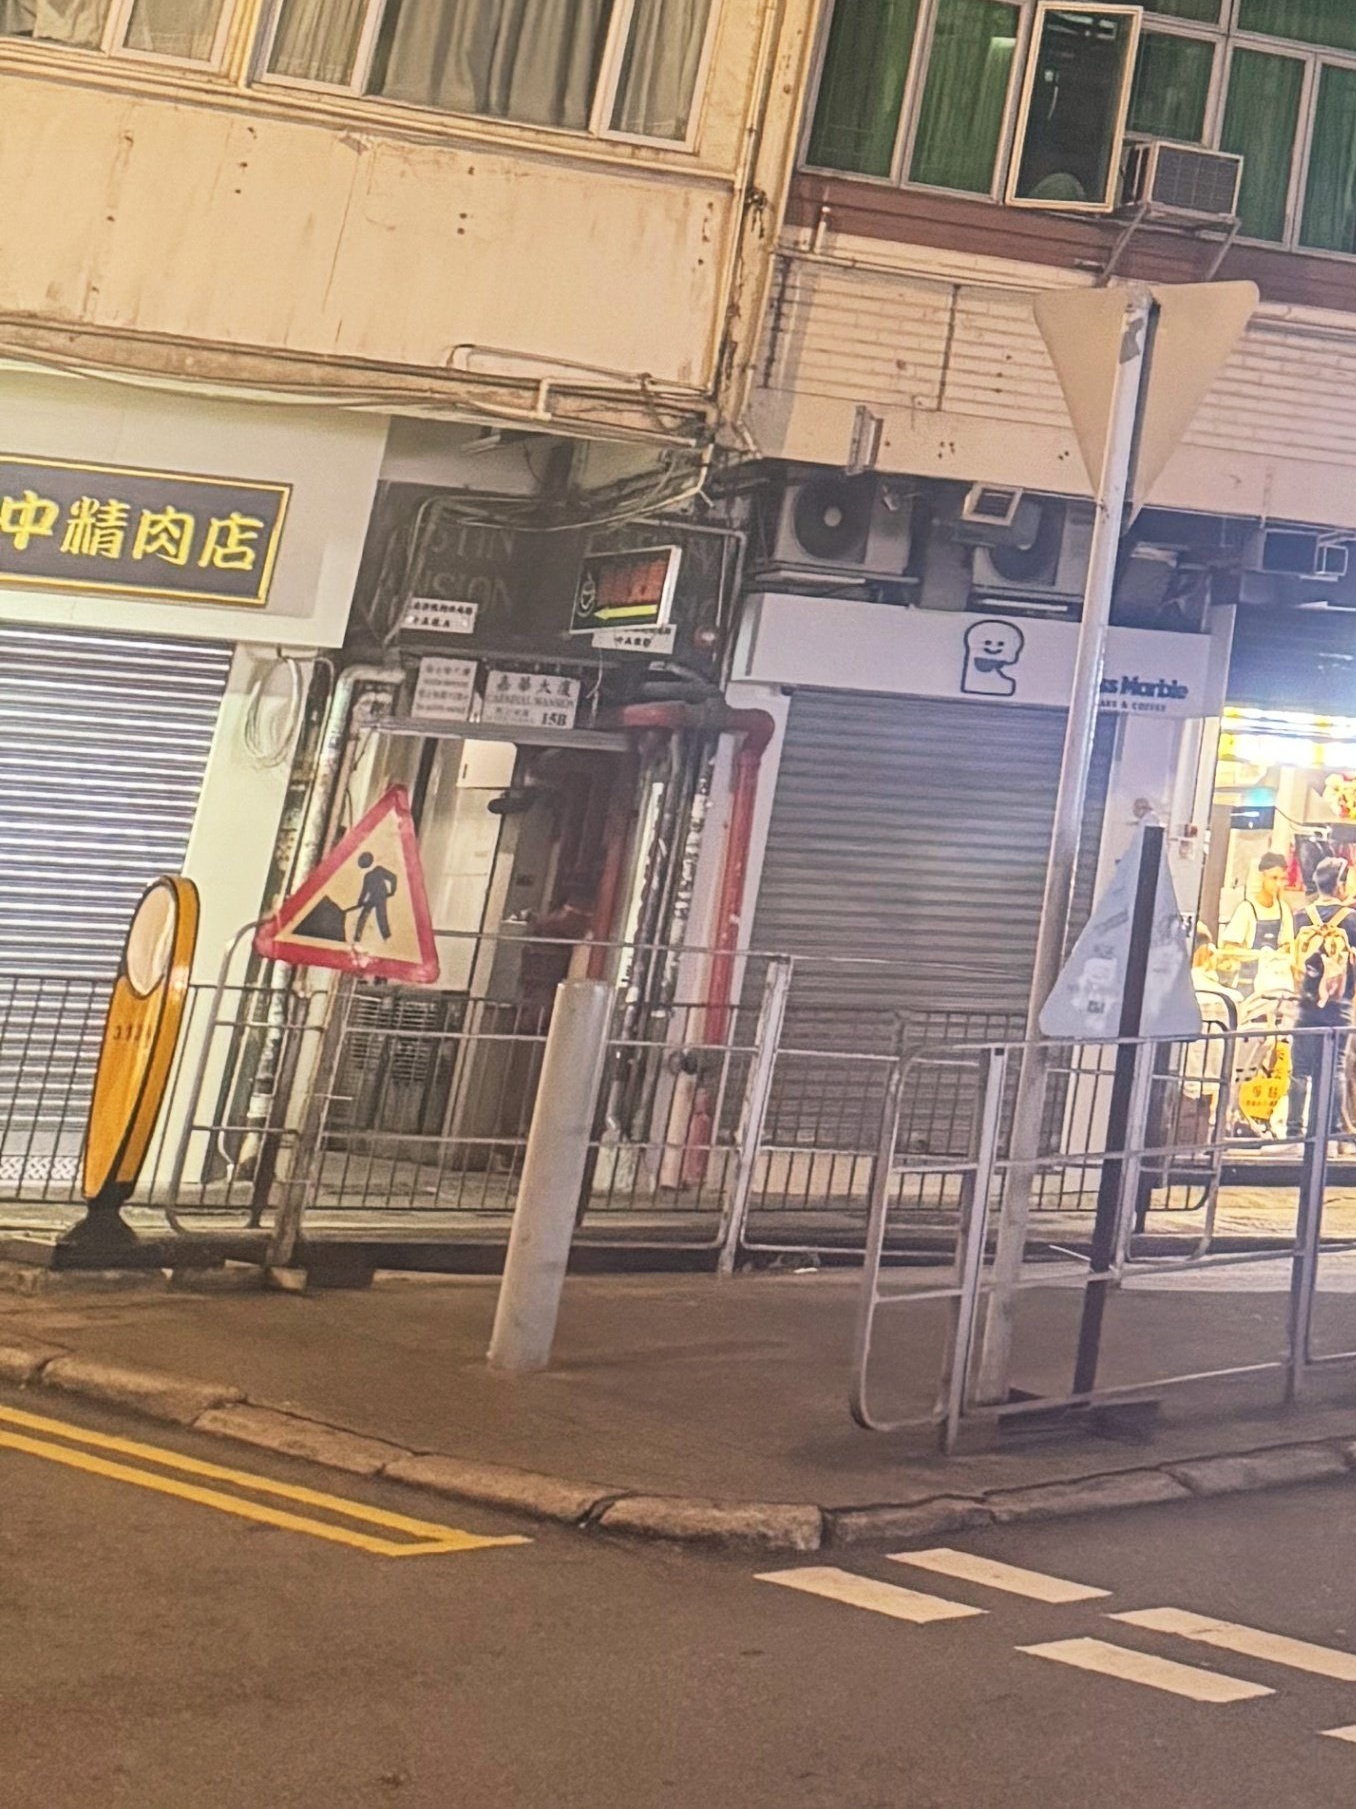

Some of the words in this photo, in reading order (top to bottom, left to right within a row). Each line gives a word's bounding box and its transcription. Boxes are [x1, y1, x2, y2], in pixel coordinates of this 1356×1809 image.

[0, 489, 265, 571] 中精肉店
[1120, 674, 1190, 700] Marble
[541, 712, 567, 727] 15B
